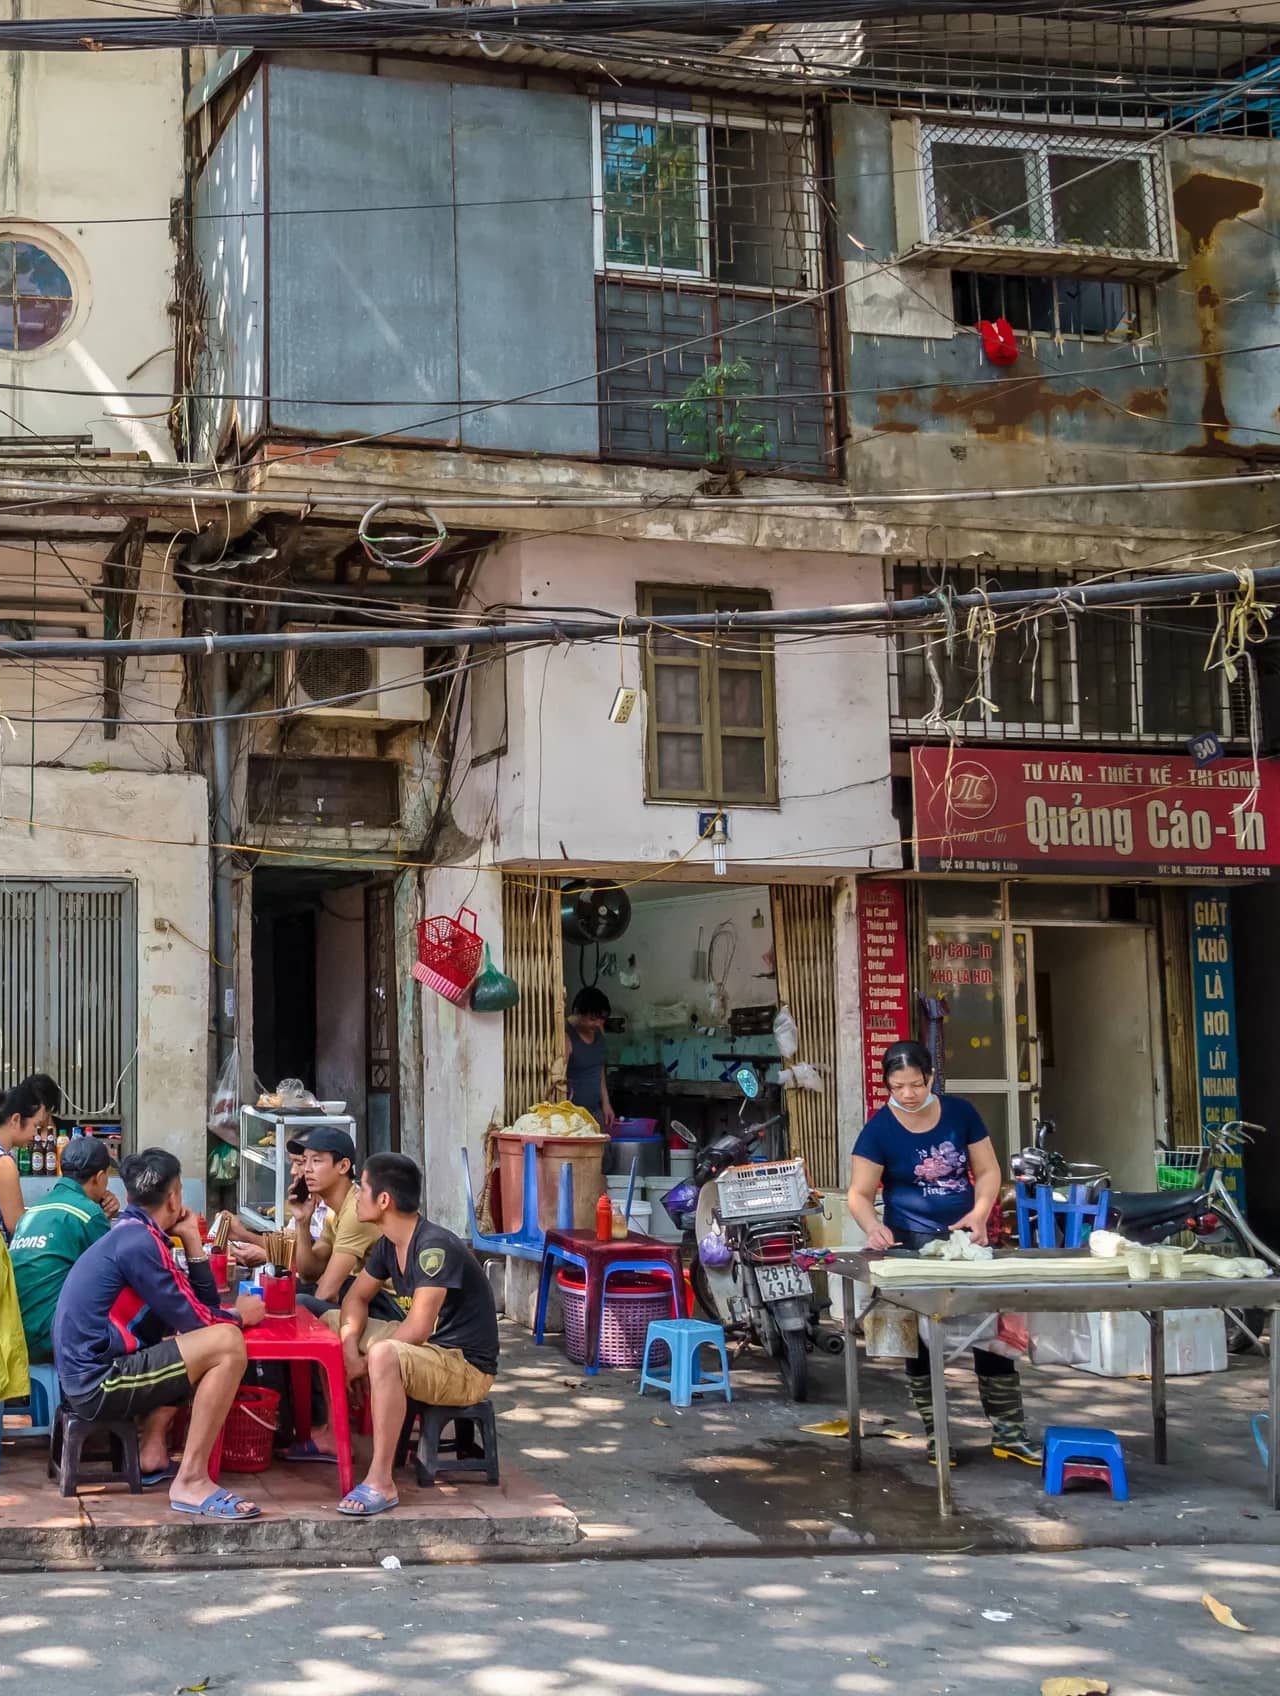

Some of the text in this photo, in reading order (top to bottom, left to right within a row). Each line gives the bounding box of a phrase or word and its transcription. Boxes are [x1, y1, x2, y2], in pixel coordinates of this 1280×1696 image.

[1193, 738, 1217, 760] 30
[1022, 761, 1044, 781] TƯ
[1048, 760, 1084, 782] VẤN
[1098, 763, 1145, 784] THIẾT
[1150, 763, 1173, 785] KẾ
[1188, 769, 1214, 786] THI
[1025, 792, 1134, 856] Quảng
[1204, 969, 1225, 1000] LÀ
